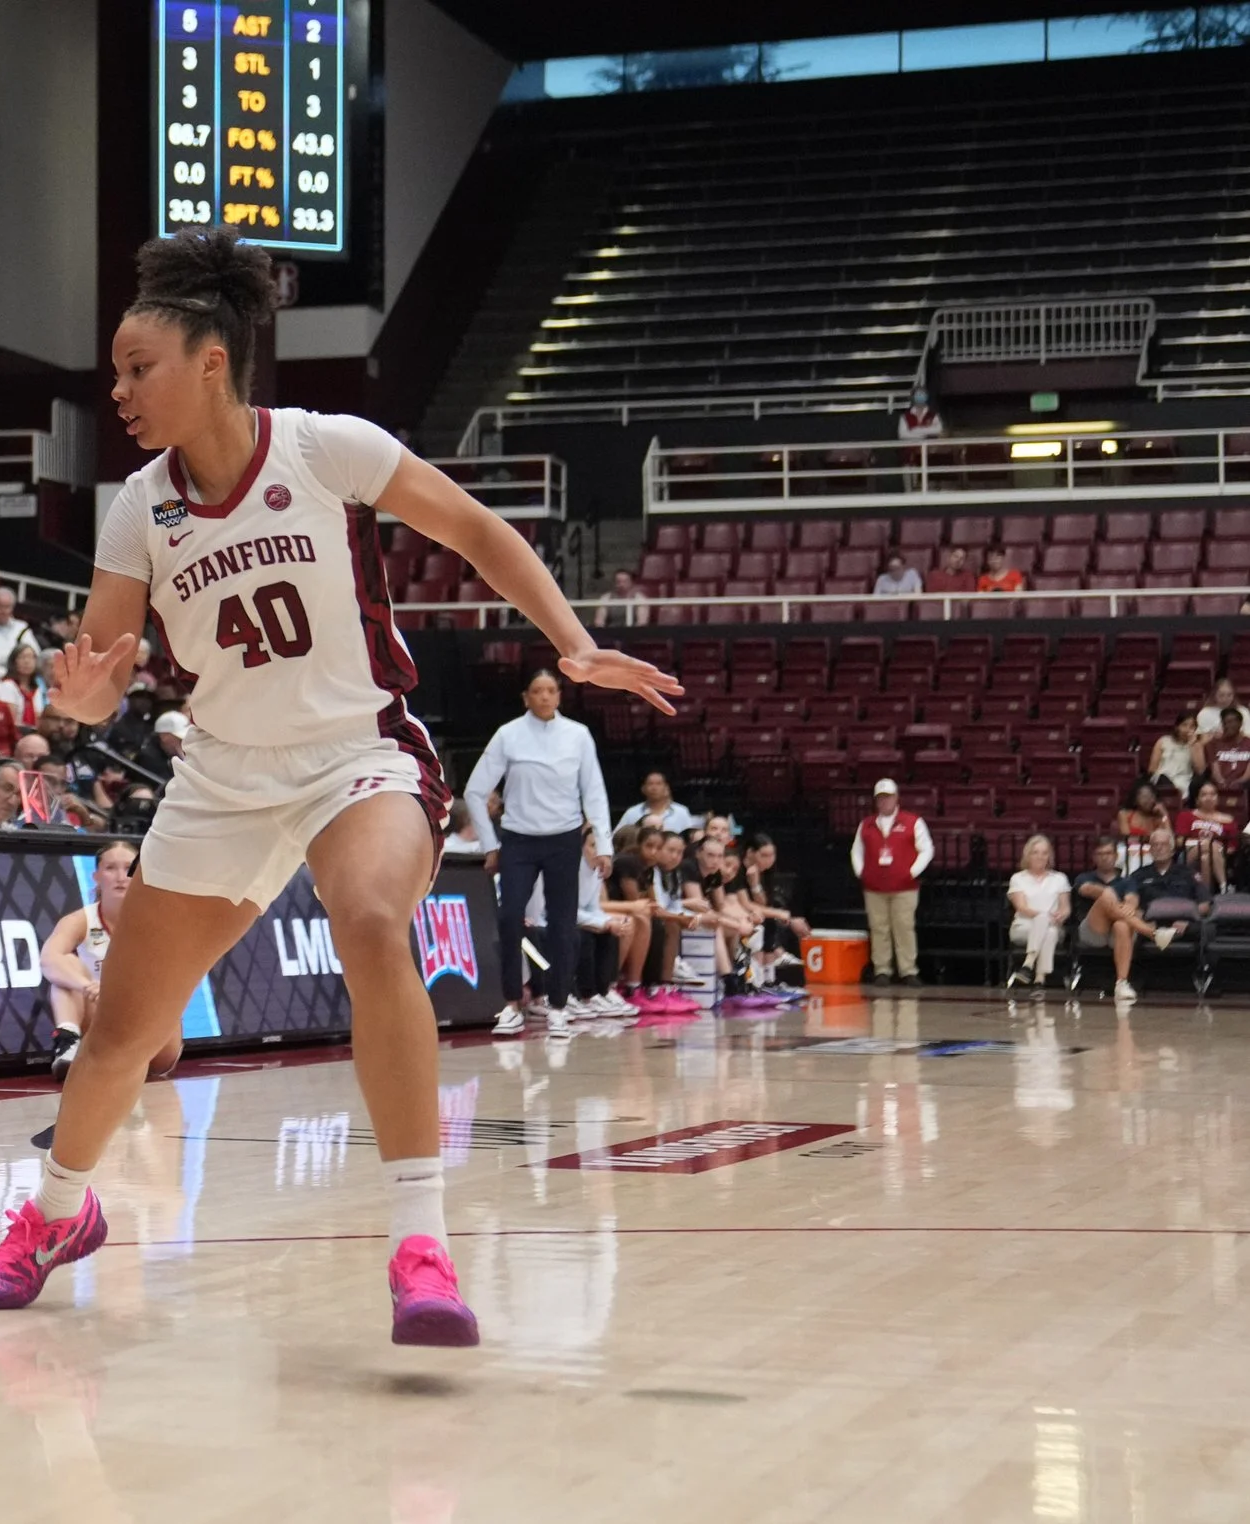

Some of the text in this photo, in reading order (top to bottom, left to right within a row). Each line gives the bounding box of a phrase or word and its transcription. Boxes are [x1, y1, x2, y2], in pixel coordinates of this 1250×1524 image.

[233, 15, 271, 37] AST
[306, 19, 322, 43] 2
[182, 46, 321, 80] 3 STL 1
[182, 84, 322, 118] 3 TO 3
[168, 122, 211, 147] 66.7
[174, 161, 206, 185] 0.0
[298, 170, 329, 194] 0.0
[168, 198, 211, 224] 33.3
[292, 207, 334, 232] 33.3
[155, 506, 185, 520] WBIT
[172, 534, 316, 602] STANFORD
[216, 580, 313, 669] 40
[807, 945, 823, 973] G
